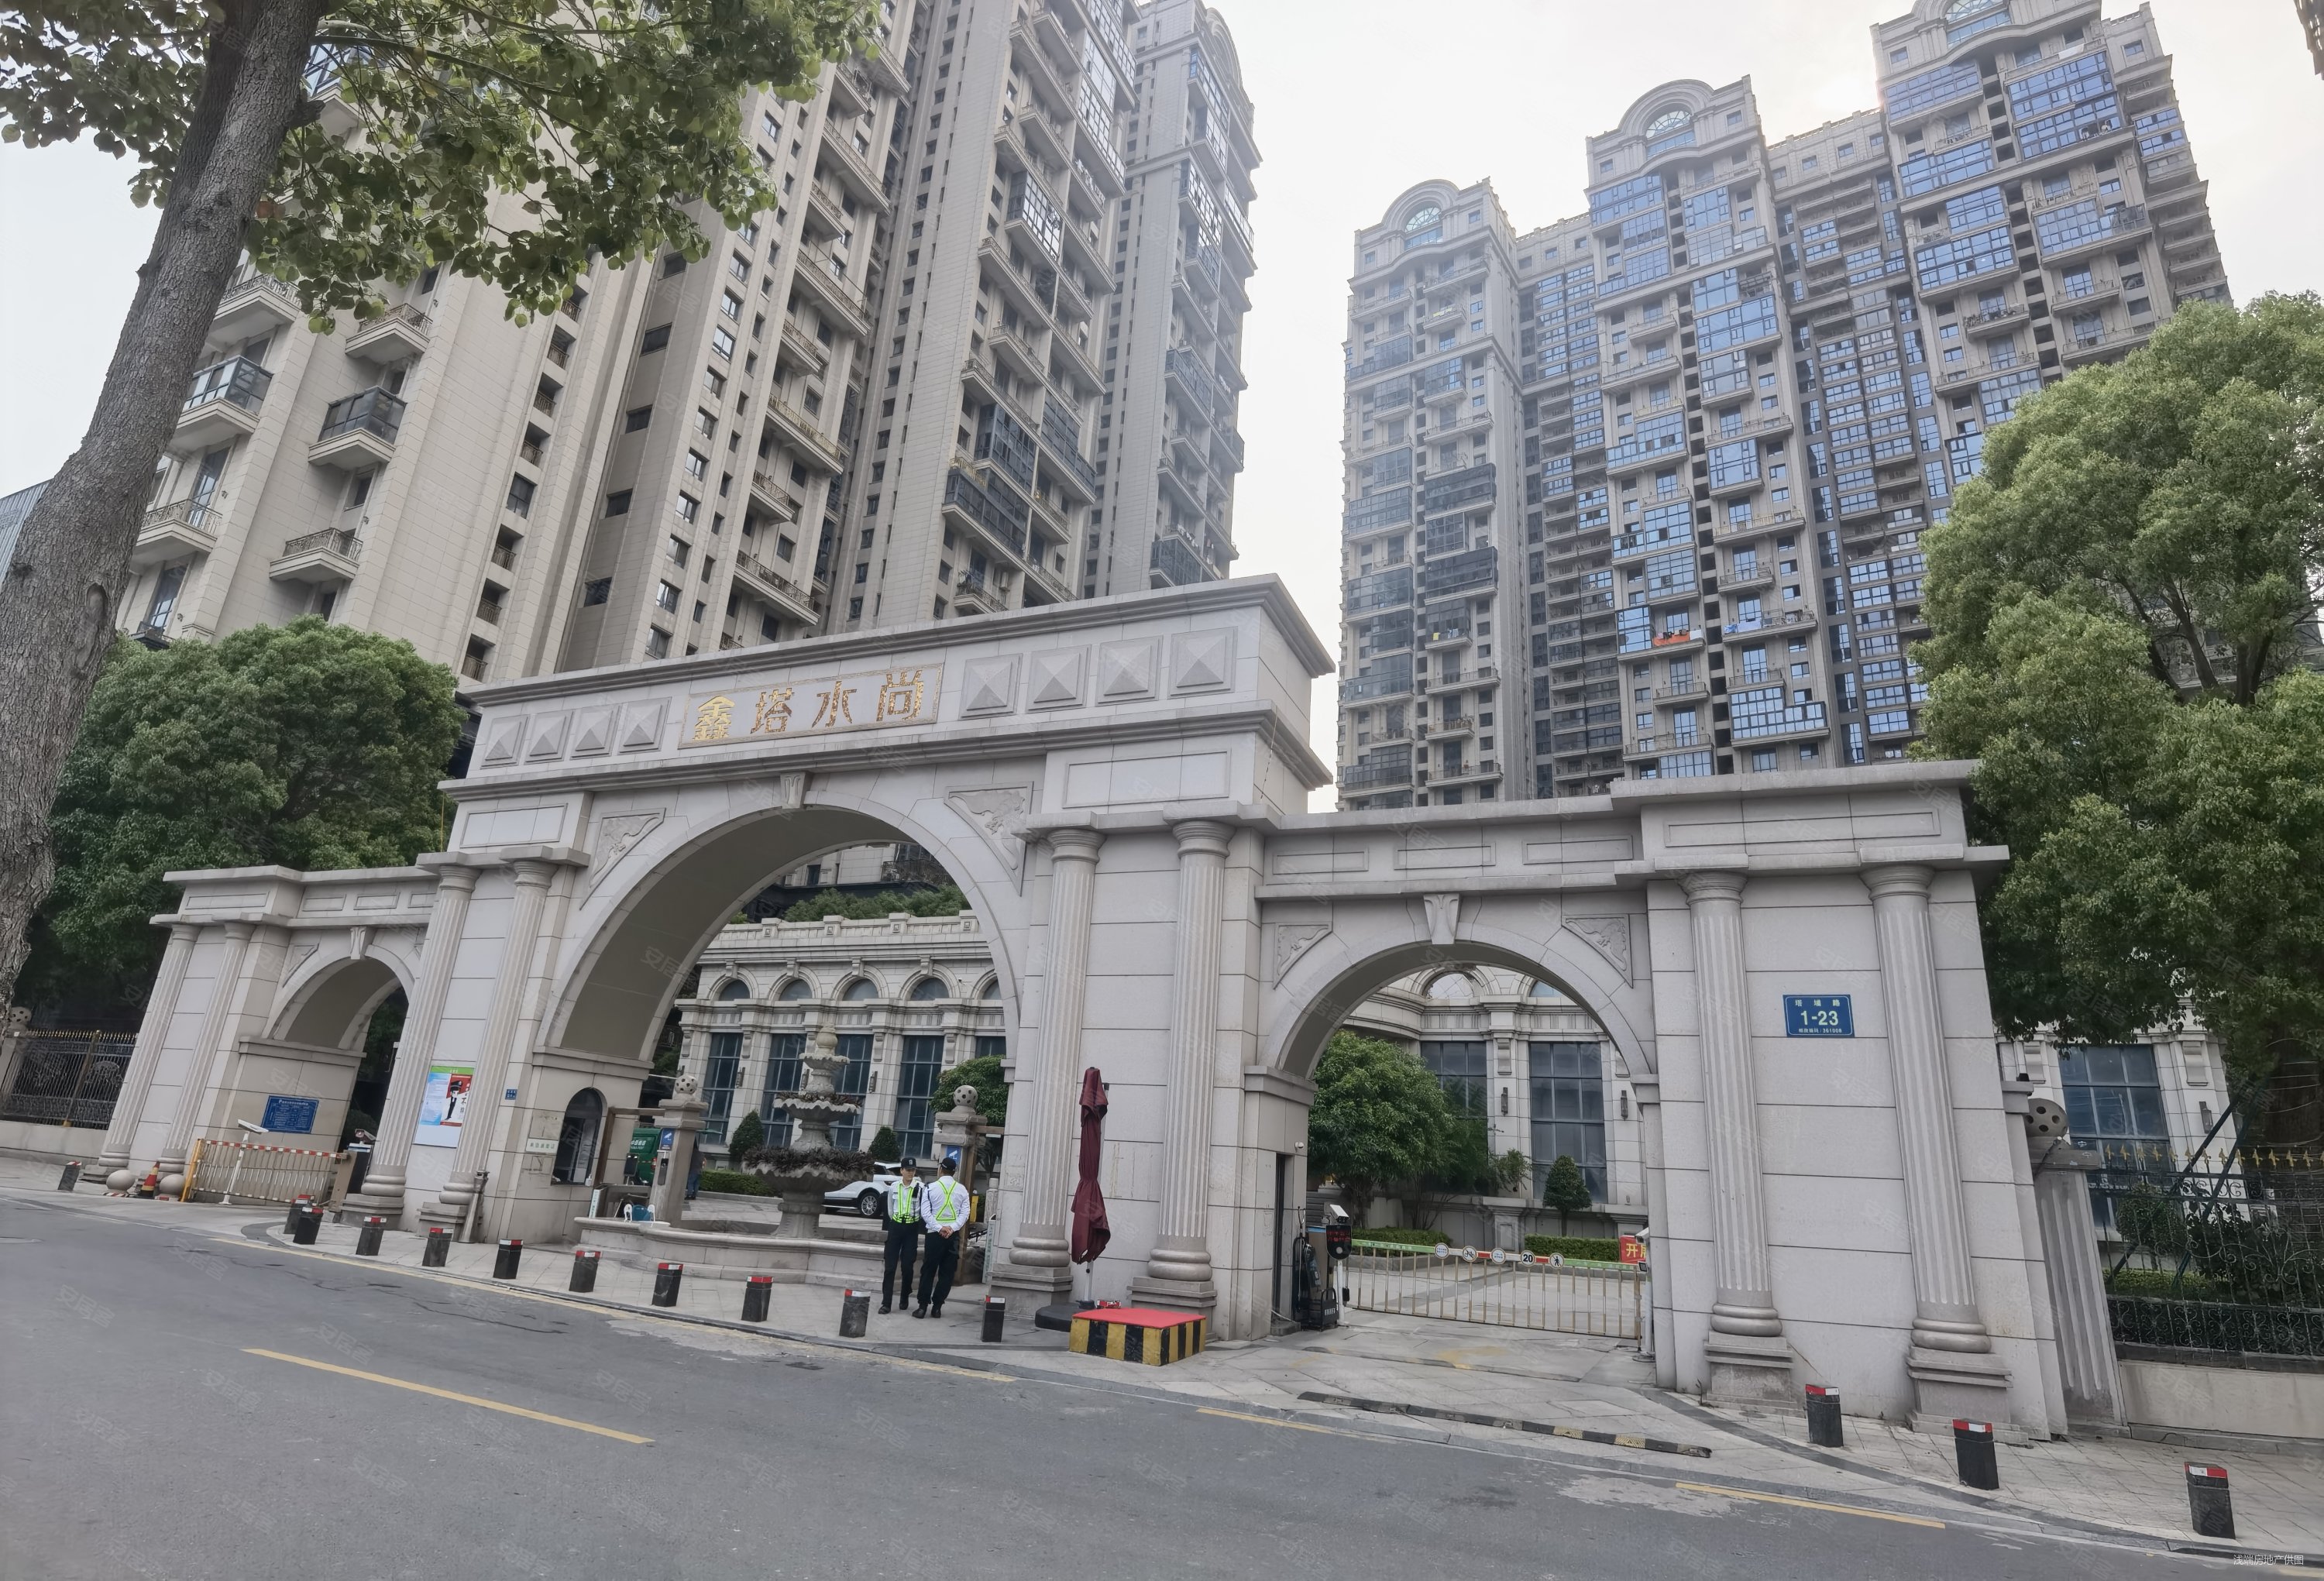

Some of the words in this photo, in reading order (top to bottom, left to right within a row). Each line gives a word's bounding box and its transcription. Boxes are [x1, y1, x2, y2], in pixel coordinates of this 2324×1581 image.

[693, 669, 924, 741] 鑫塔水尚
[1795, 998, 1841, 1008] 塔埔路
[1800, 1010, 1839, 1026] 1-23
[1523, 1253, 1533, 1263] 20
